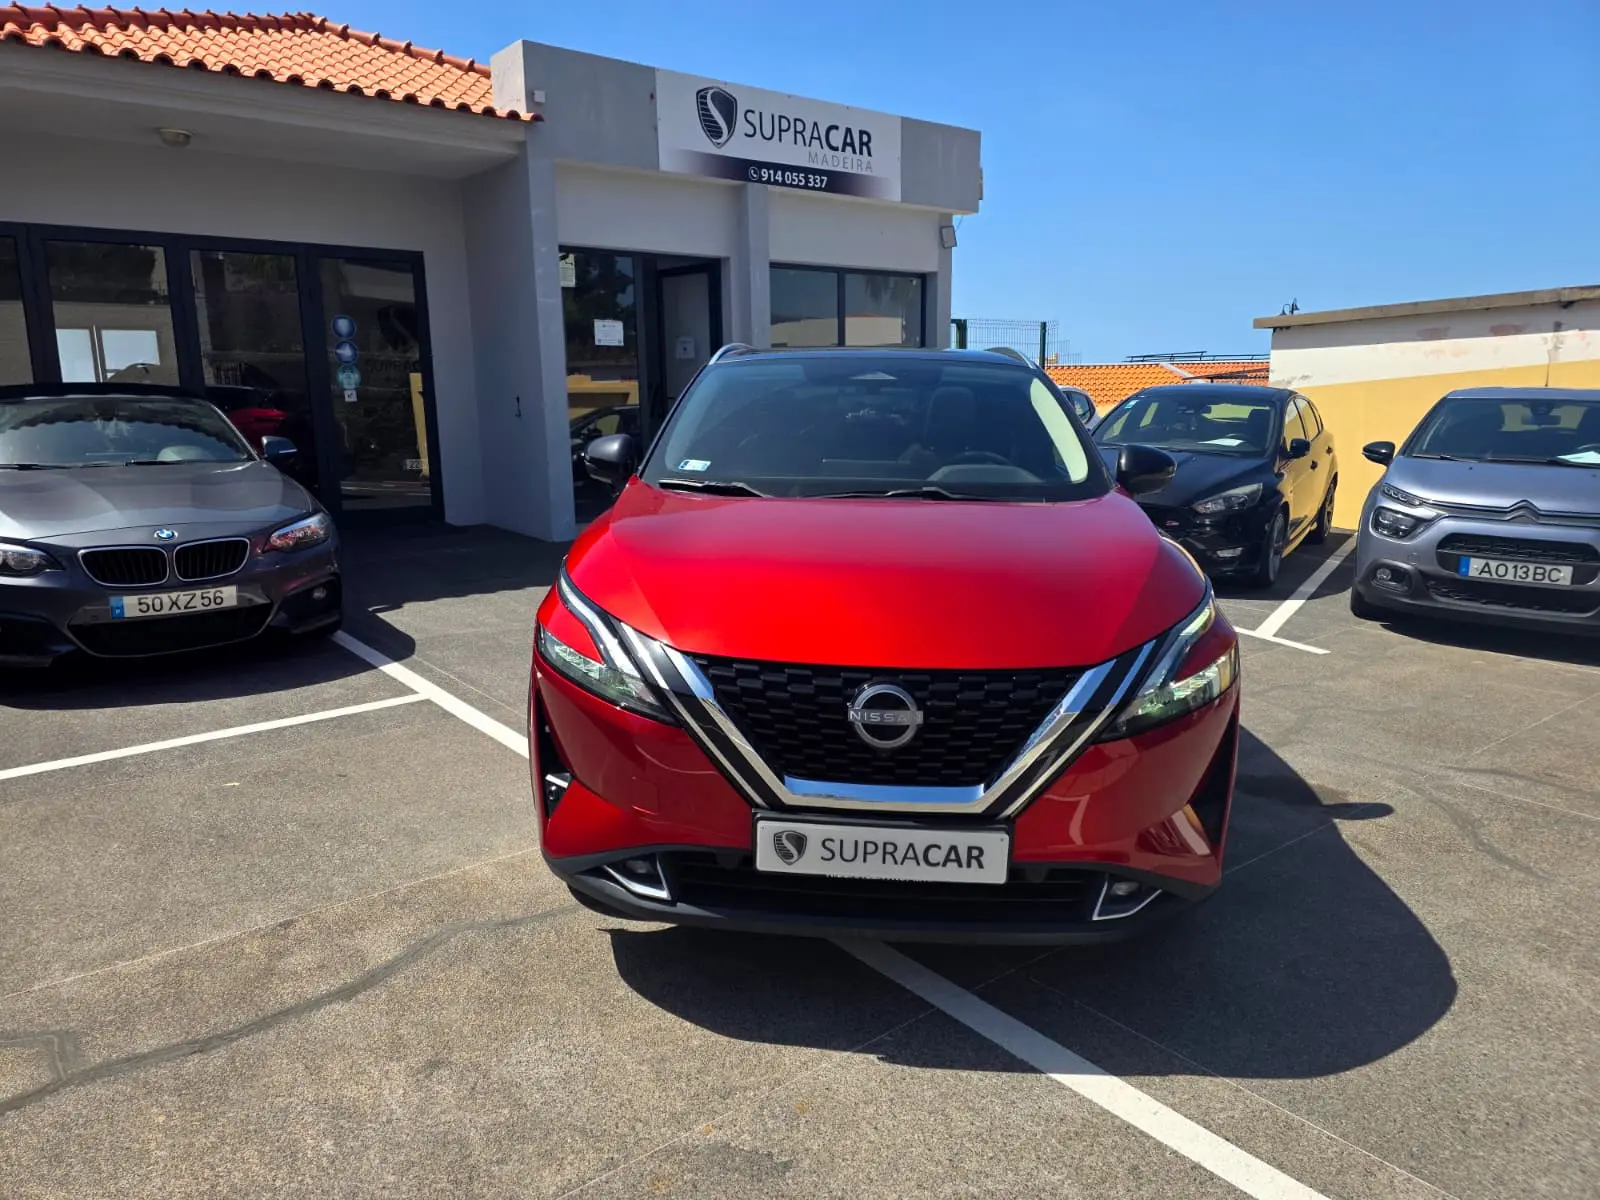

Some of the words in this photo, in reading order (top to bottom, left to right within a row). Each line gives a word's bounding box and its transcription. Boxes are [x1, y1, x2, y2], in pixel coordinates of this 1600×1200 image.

[743, 109, 872, 157] SUPRACAR
[808, 151, 873, 173] MADEIRA
[761, 168, 782, 183] 914
[784, 171, 805, 186] 055
[807, 174, 828, 188] 337
[849, 710, 922, 723] NISSAN
[820, 838, 985, 870] SUPRACAR
